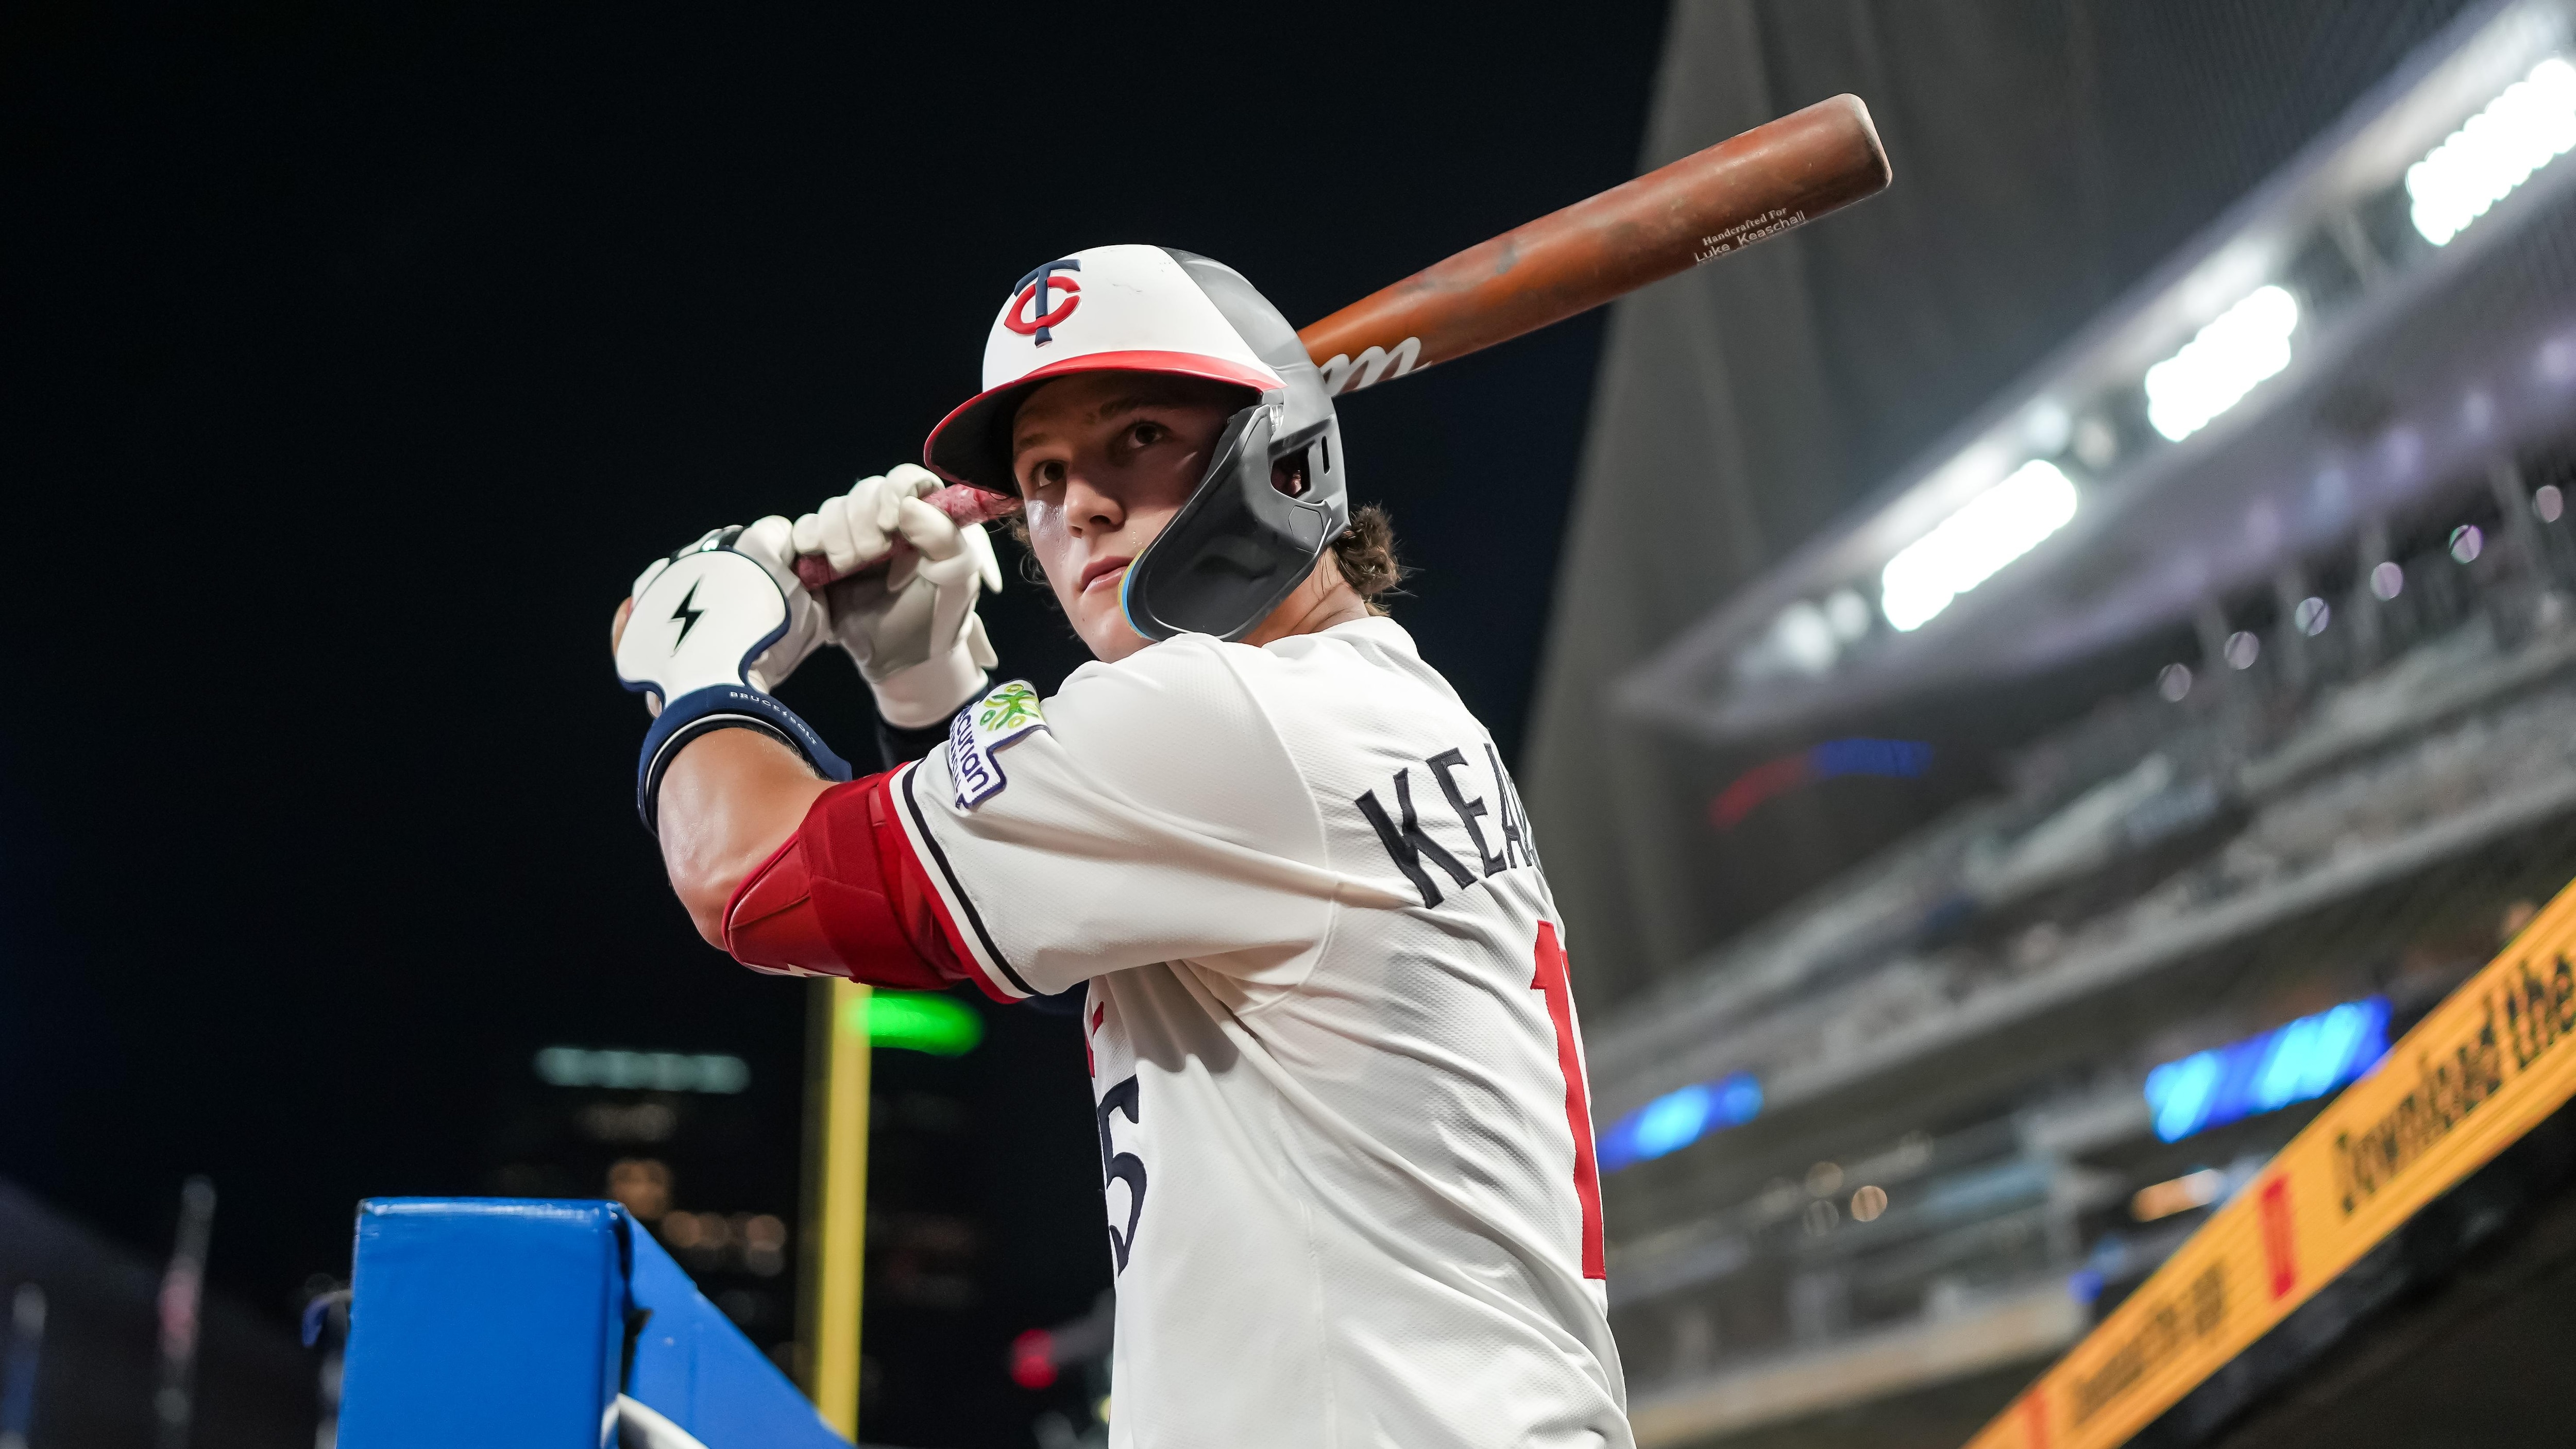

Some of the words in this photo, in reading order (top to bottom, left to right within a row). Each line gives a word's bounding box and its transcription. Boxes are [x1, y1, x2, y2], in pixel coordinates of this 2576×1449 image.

[1693, 242, 1730, 262] Luke
[1736, 210, 1806, 248] Keaschall
[1702, 213, 1767, 246] Handcrafted
[1768, 207, 1787, 220] For
[730, 691, 781, 712] BRUCE
[1530, 920, 1606, 1280] 1
